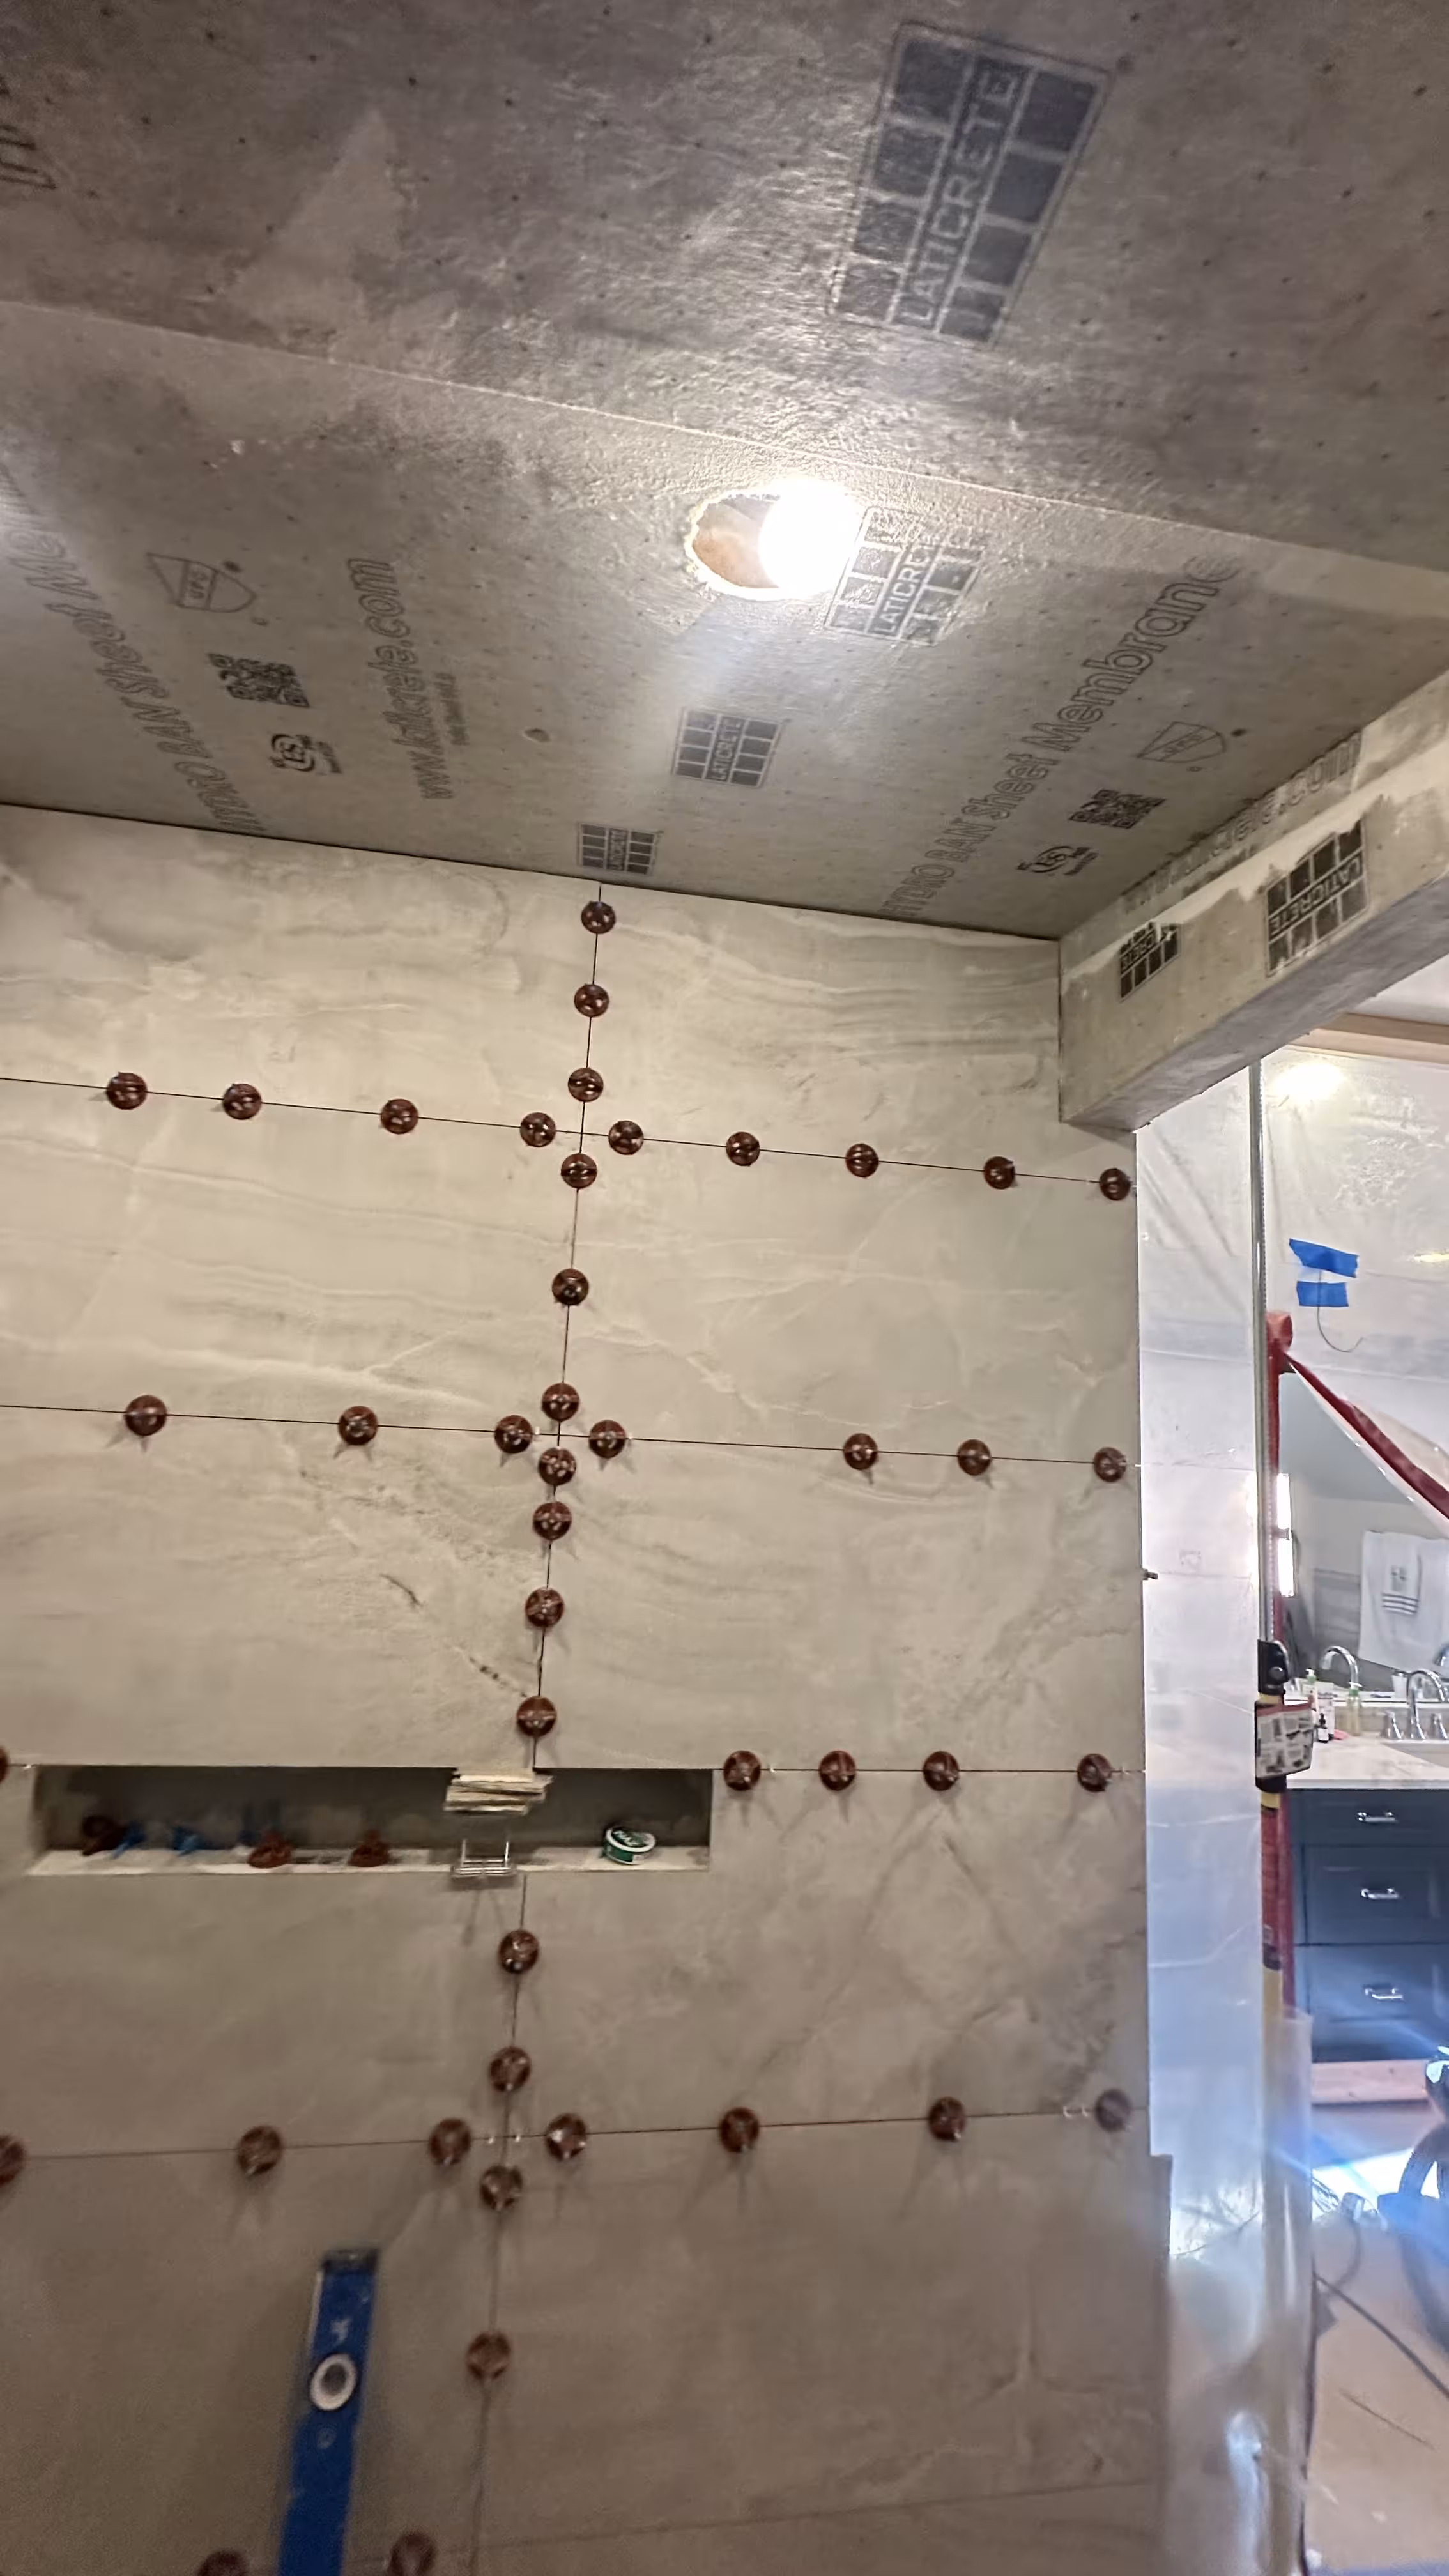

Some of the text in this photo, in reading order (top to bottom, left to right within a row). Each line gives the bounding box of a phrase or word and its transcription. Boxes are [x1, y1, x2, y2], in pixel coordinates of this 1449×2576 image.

[900, 68, 1022, 322] LATICRETE
[44, 602, 170, 699] Sheet
[121, 696, 213, 759] BAN
[924, 817, 998, 863] BAN
[961, 751, 1061, 822] Sheet
[1022, 555, 1243, 753] Membrane
[1270, 856, 1361, 930] LATICRETE
